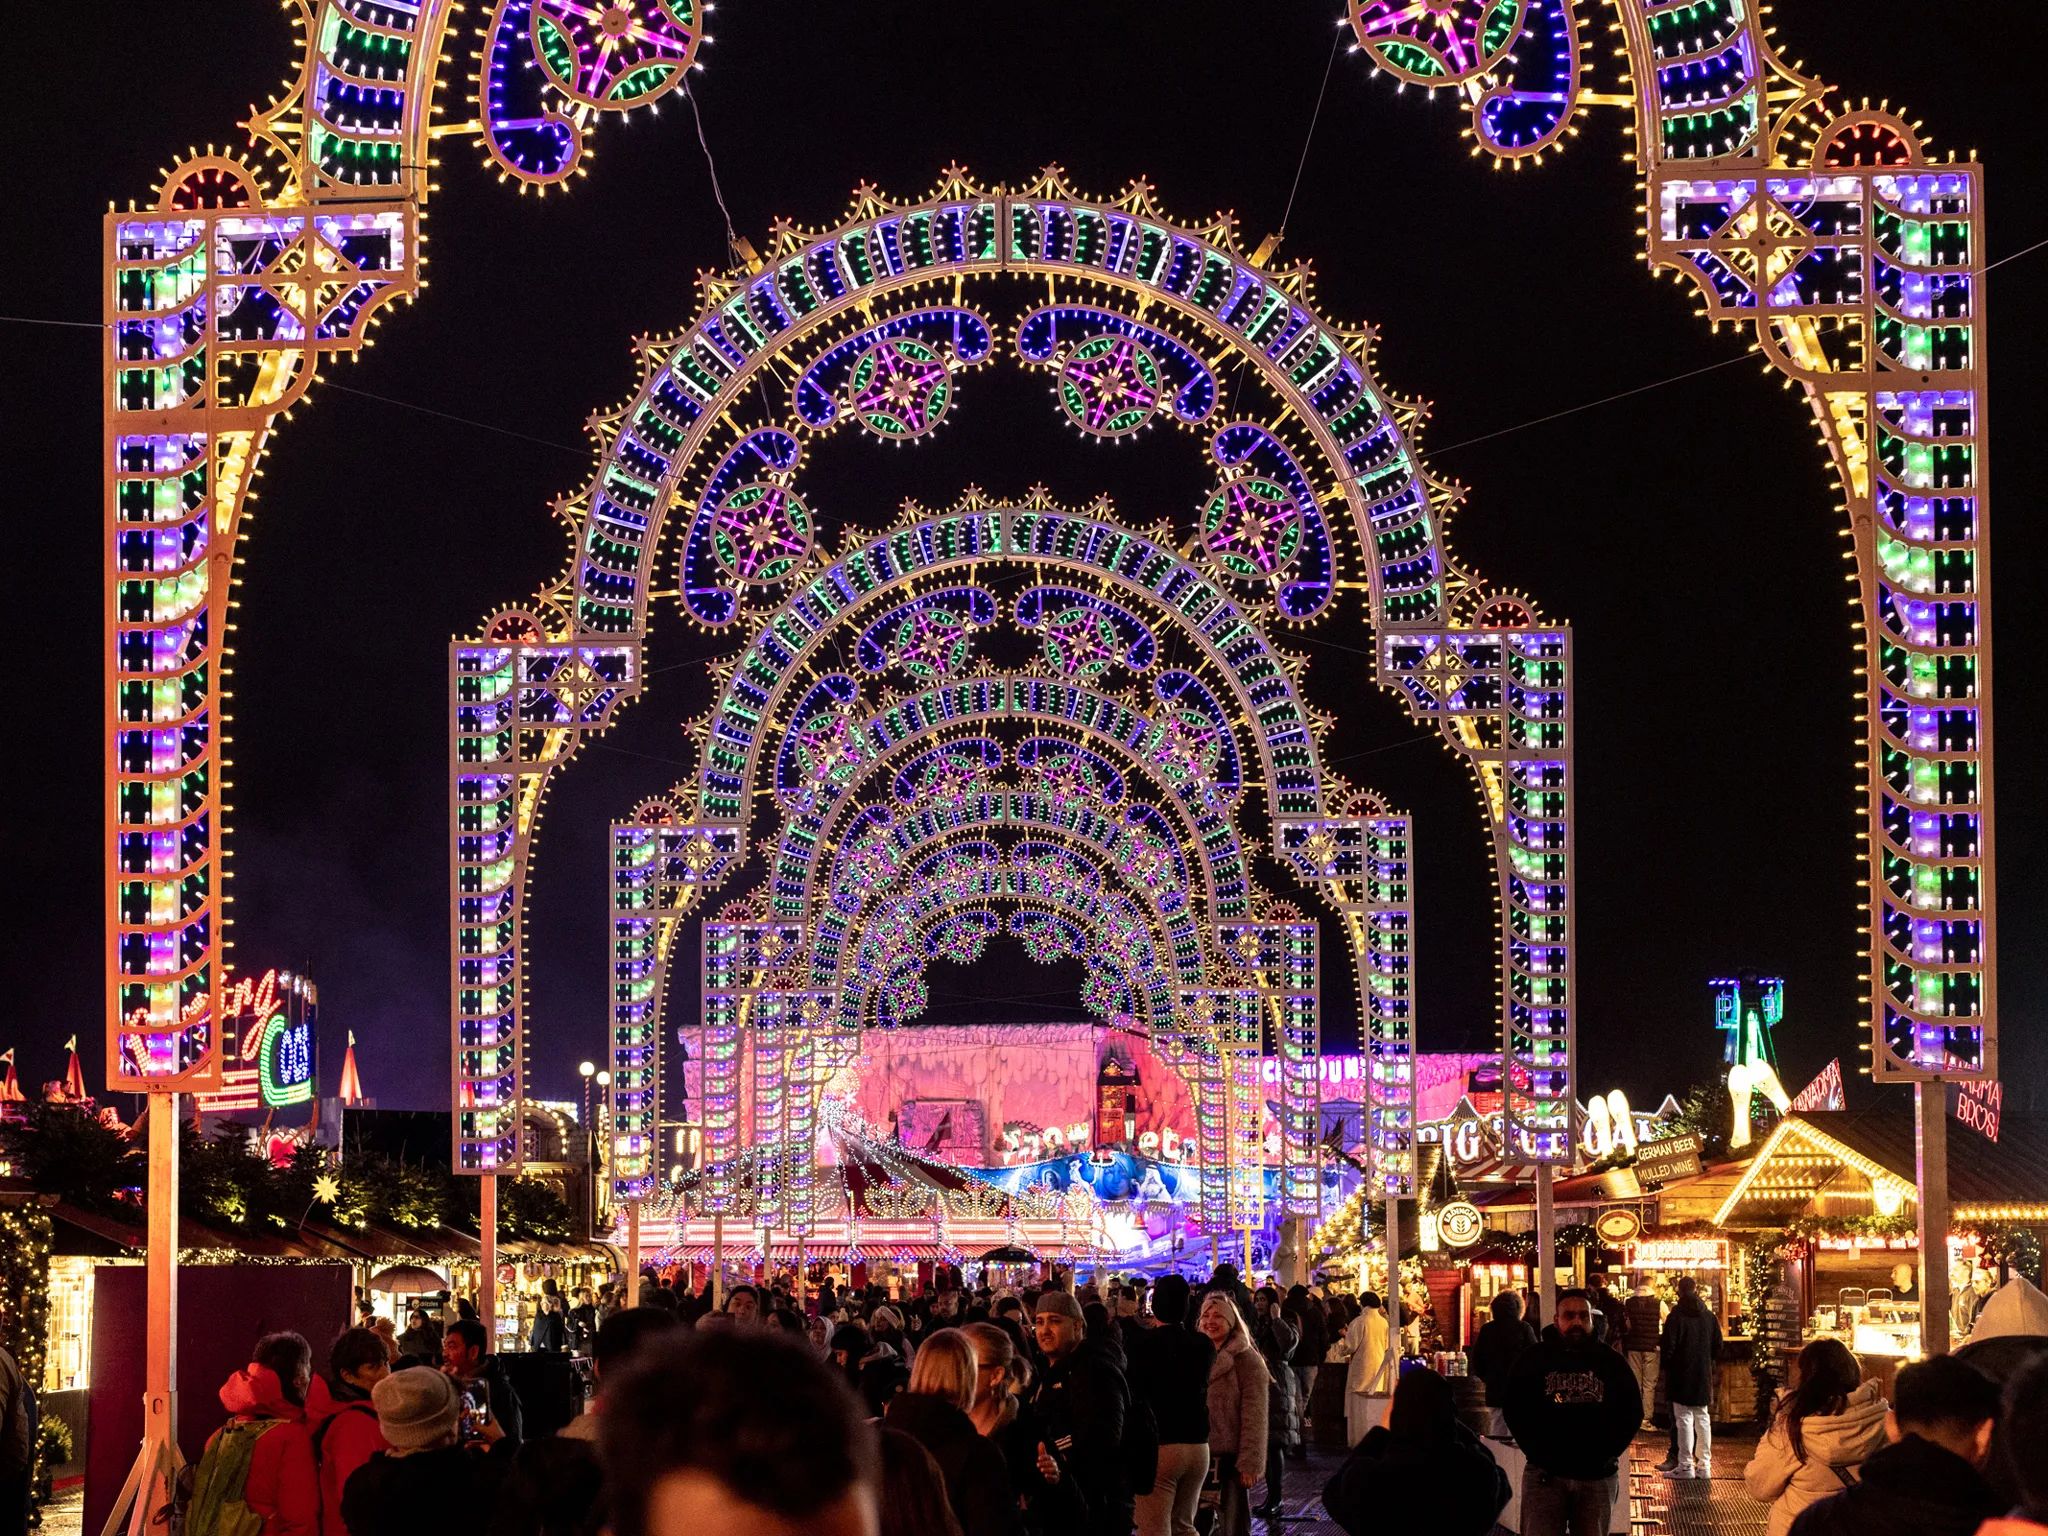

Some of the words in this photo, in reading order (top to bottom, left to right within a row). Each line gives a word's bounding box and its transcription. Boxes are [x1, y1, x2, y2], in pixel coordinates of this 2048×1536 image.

[1638, 1142, 1672, 1161] GERMAN
[1673, 1138, 1696, 1153] BEER
[1638, 1164, 1670, 1180] MULLED
[1671, 1160, 1694, 1174] WINE
[1444, 1207, 1477, 1223] ERDINGER
